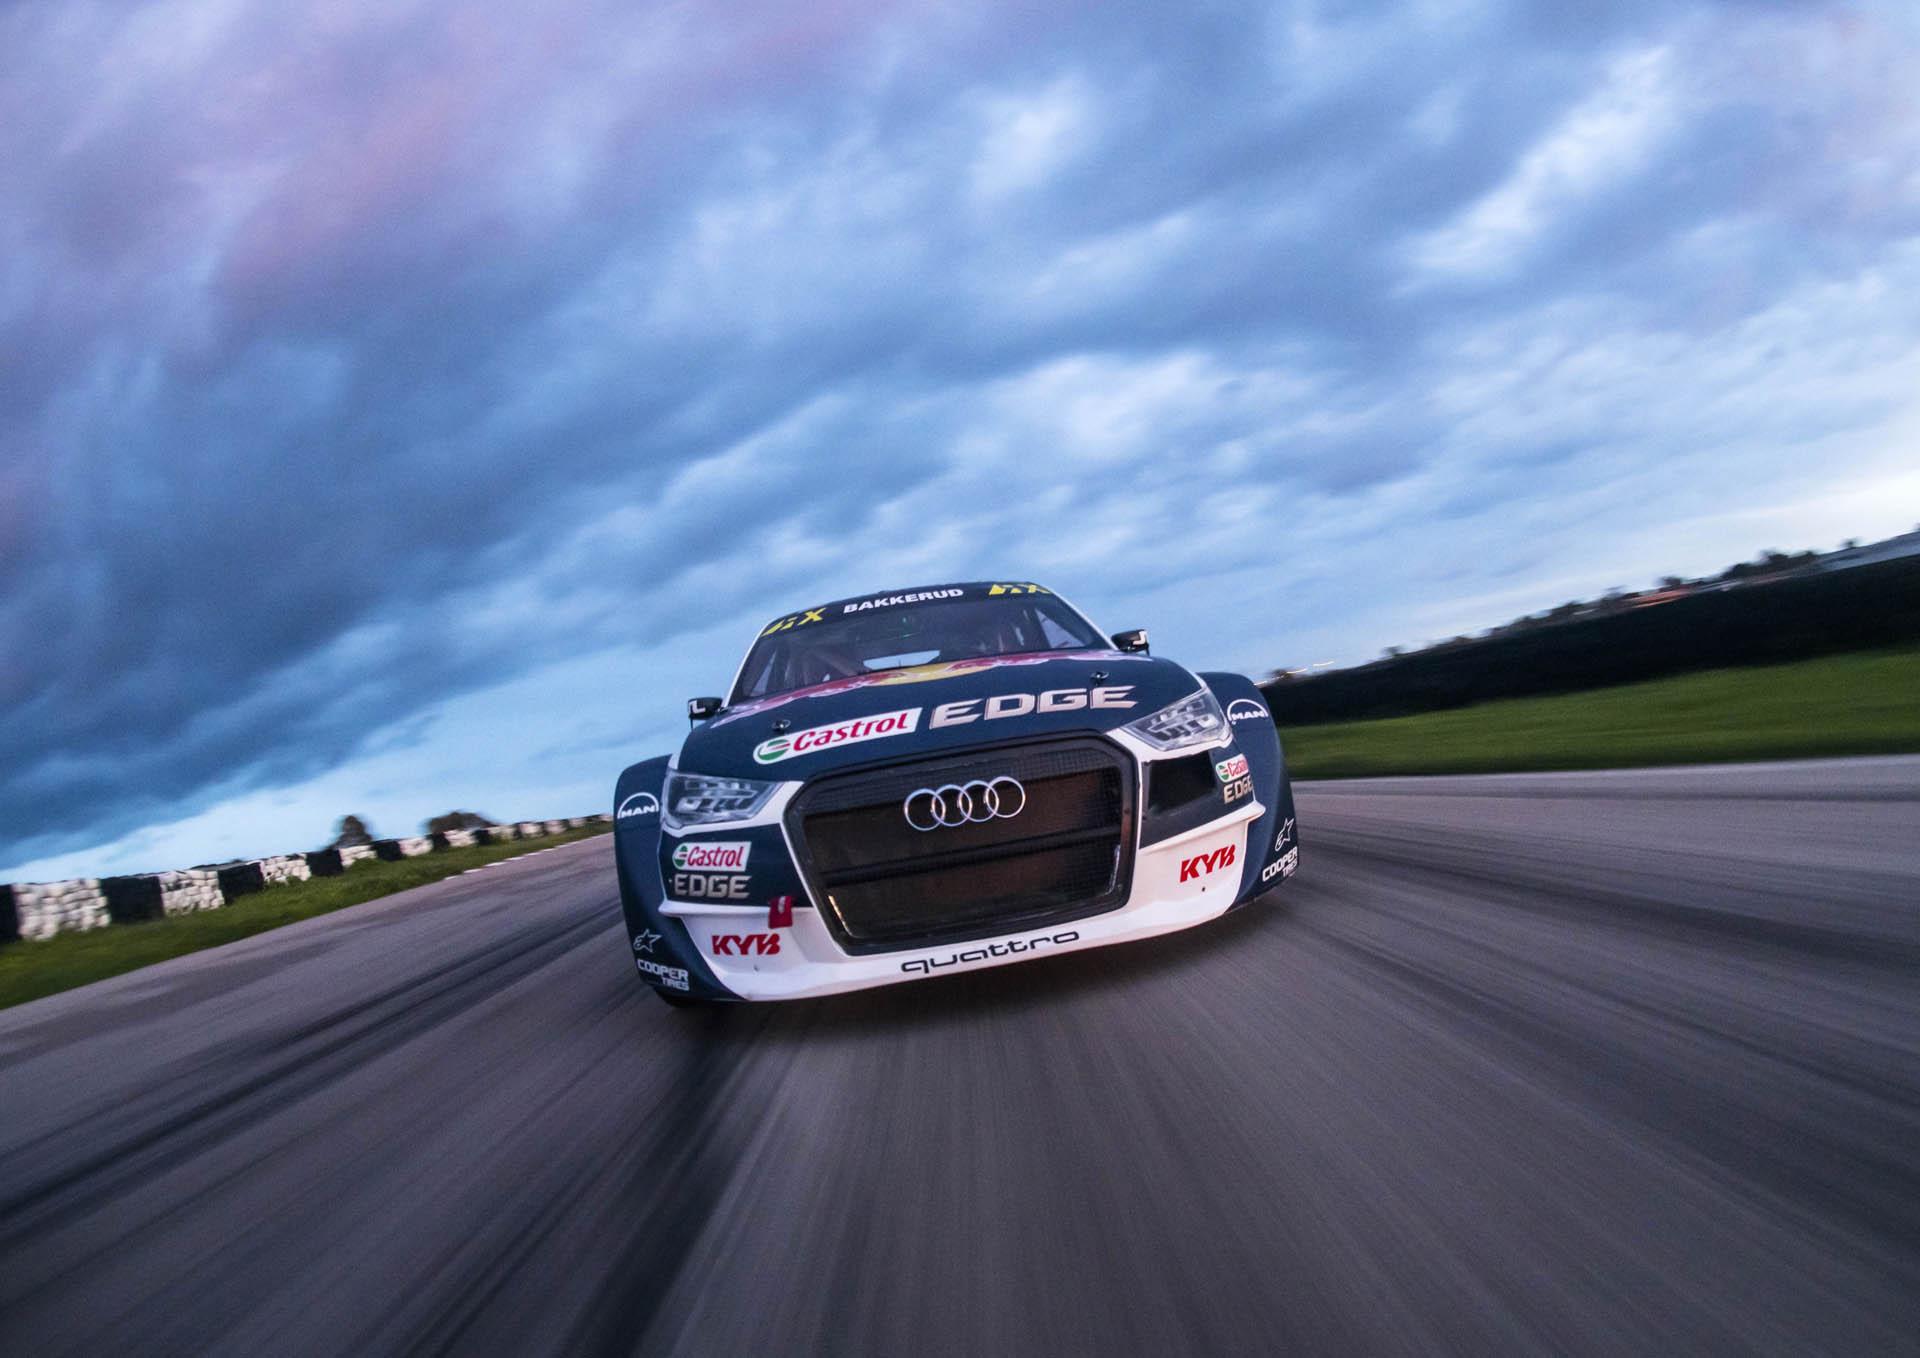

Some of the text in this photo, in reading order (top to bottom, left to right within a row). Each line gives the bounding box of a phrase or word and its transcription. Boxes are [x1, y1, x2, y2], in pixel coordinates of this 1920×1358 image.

[842, 588, 965, 615] BAKKERUD
[793, 685, 1139, 752] Castrol EDGE
[687, 846, 744, 868] Castrol
[1179, 844, 1236, 883] KYB
[674, 873, 752, 899] EDGE
[711, 933, 781, 956] KYB
[900, 931, 1080, 974] quattro
[637, 958, 689, 982] COOPER
